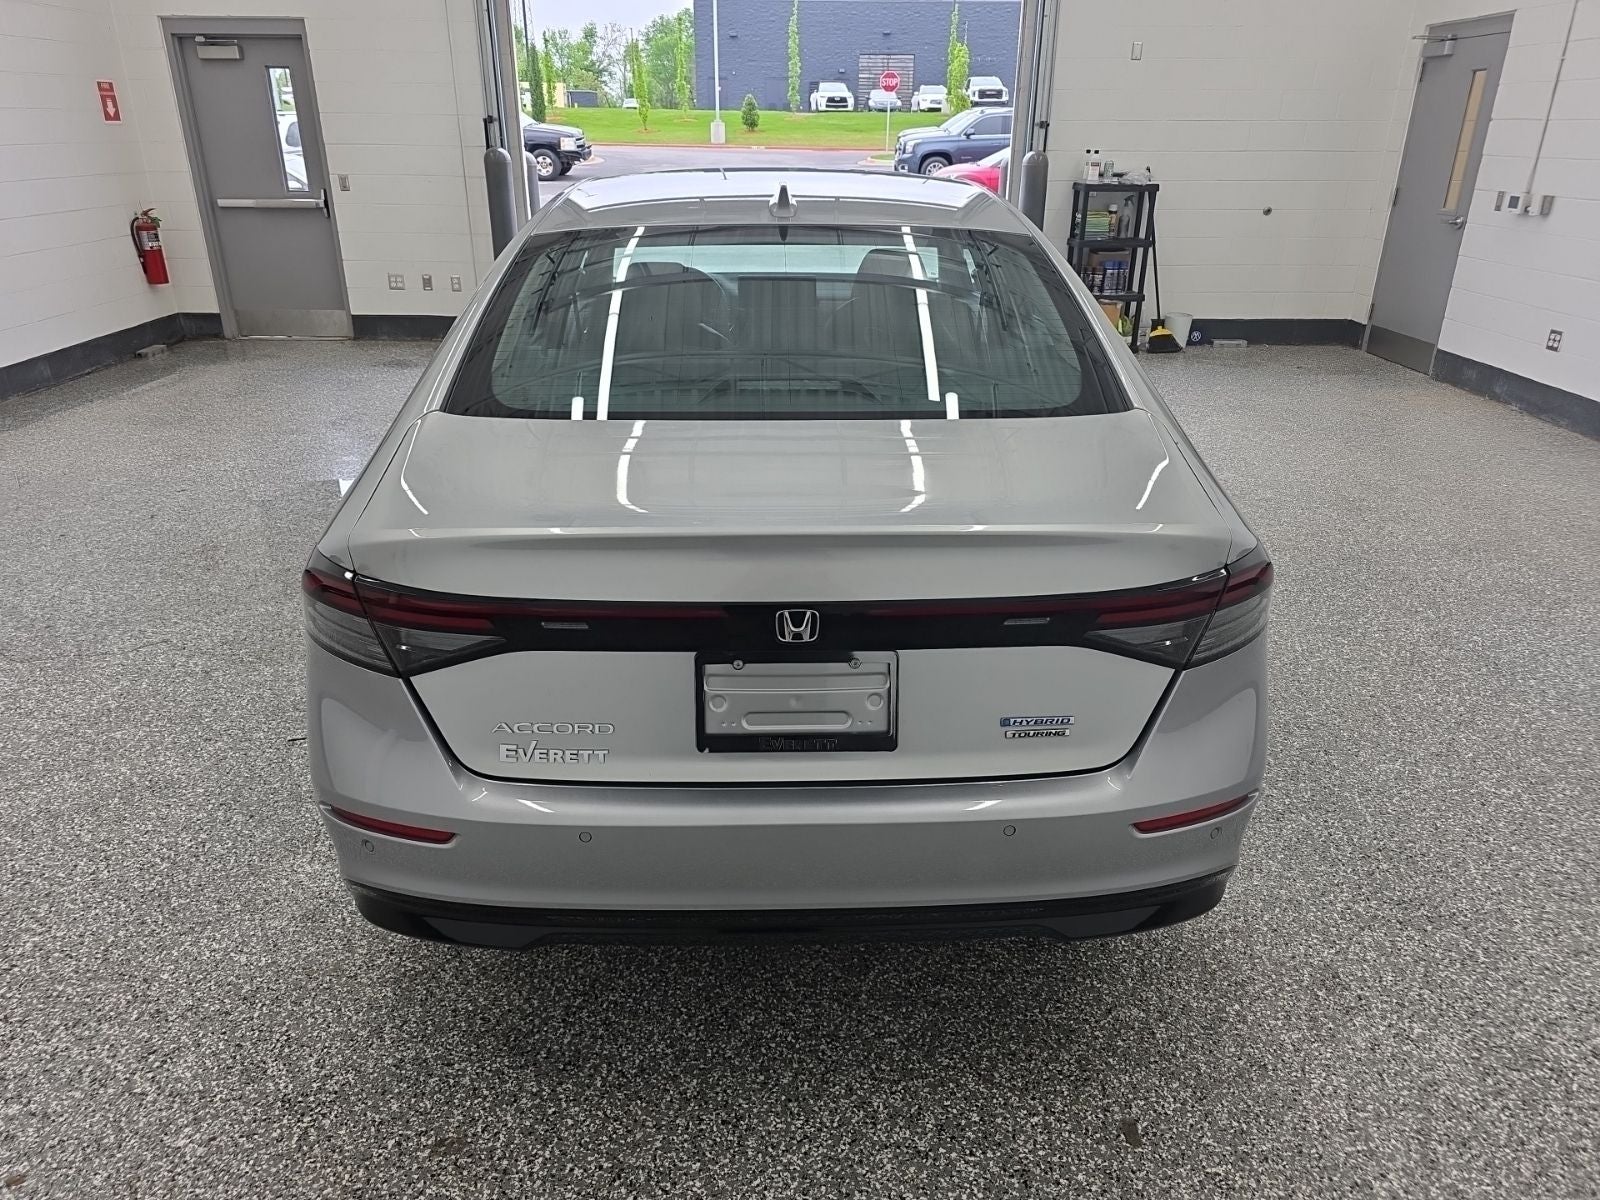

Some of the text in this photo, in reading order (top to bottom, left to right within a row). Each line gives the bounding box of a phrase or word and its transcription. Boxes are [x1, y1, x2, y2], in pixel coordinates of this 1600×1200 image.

[882, 77, 898, 87] STOP
[1012, 717, 1071, 726] HYBRID
[491, 722, 615, 735] ACCORD
[1011, 730, 1066, 738] TOURING
